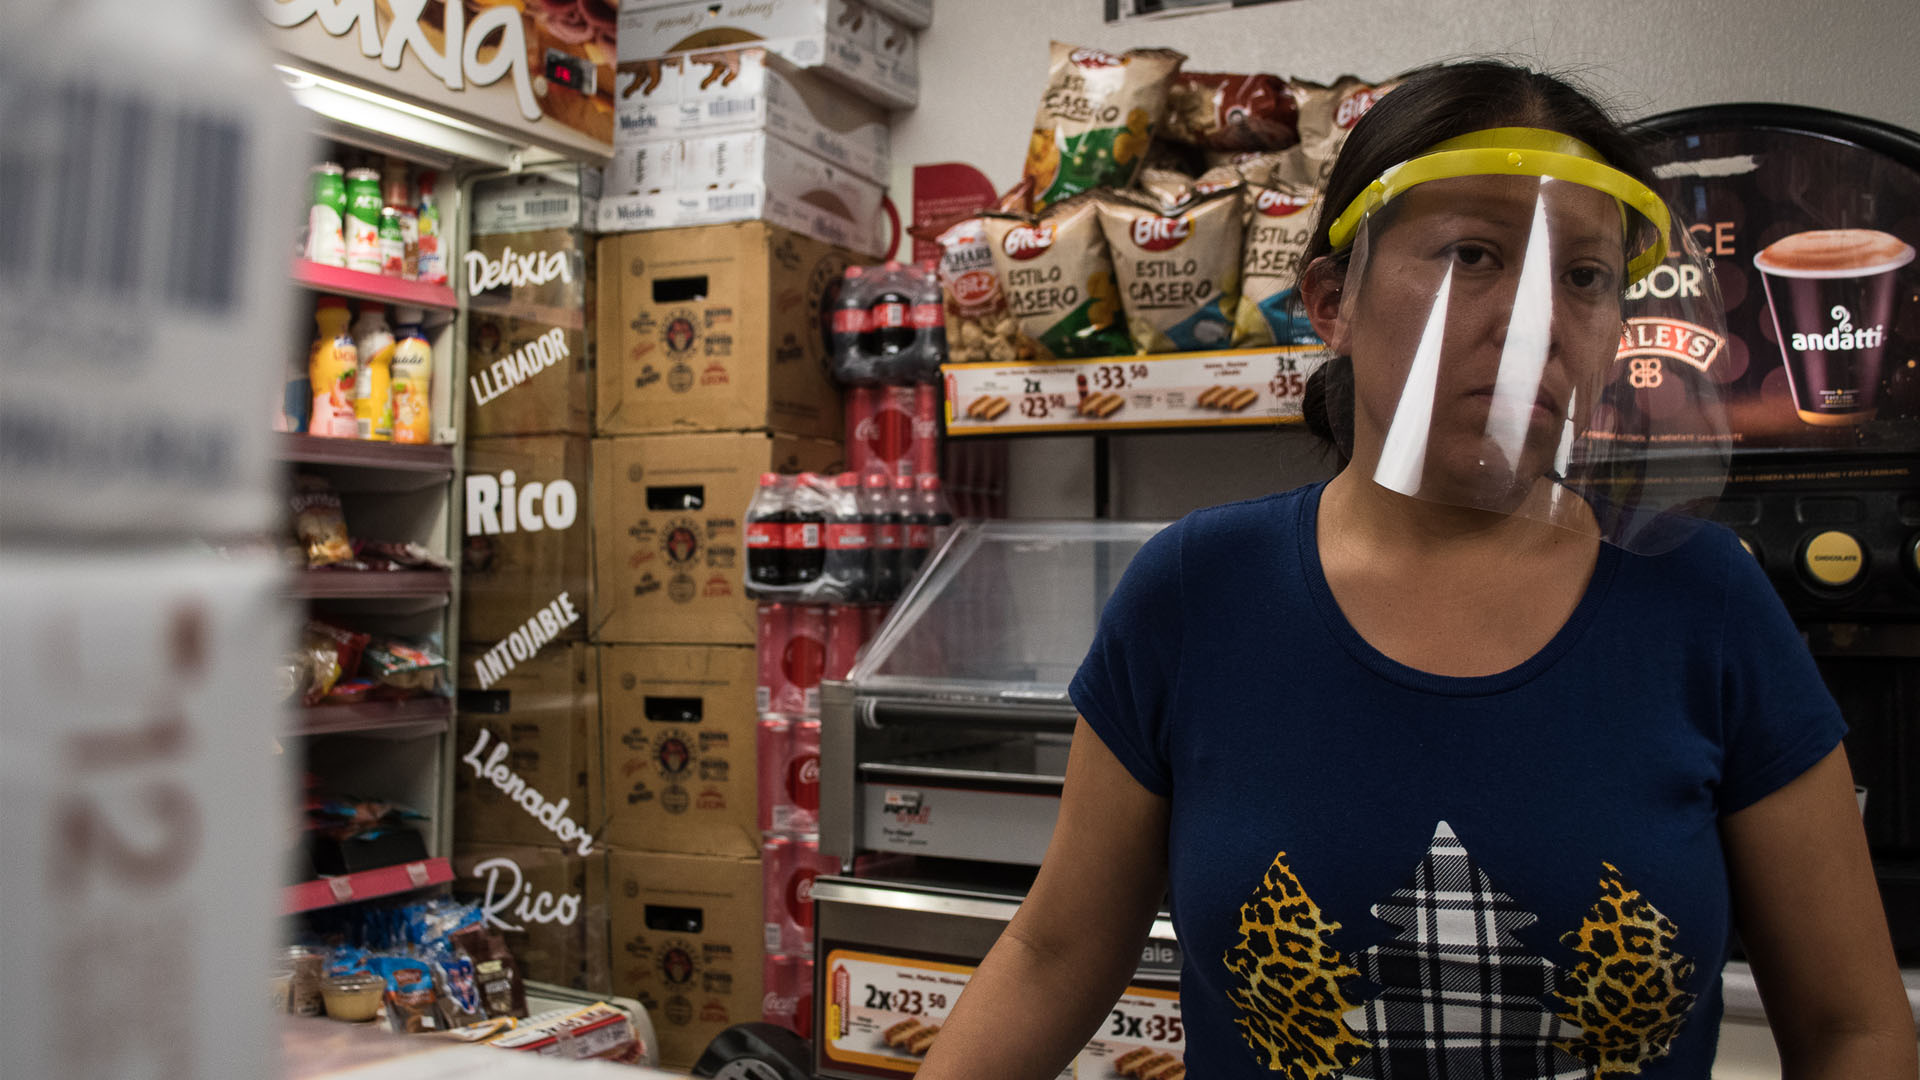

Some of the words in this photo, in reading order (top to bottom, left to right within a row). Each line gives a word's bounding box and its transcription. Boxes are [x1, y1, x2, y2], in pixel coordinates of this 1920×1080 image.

[464, 246, 572, 297] Delixia
[1008, 265, 1061, 286] ESTILO
[1135, 259, 1197, 278] ESTILO
[1245, 248, 1301, 270] ASER
[1128, 279, 1212, 305] CASERO
[1791, 324, 1884, 351] andatti
[470, 327, 570, 407] LLENADOR
[465, 469, 577, 536] Rico
[474, 591, 580, 690] ANTOJABLE
[463, 727, 594, 857] Llenador
[473, 857, 582, 932] Rico
[1142, 943, 1175, 963] ale
